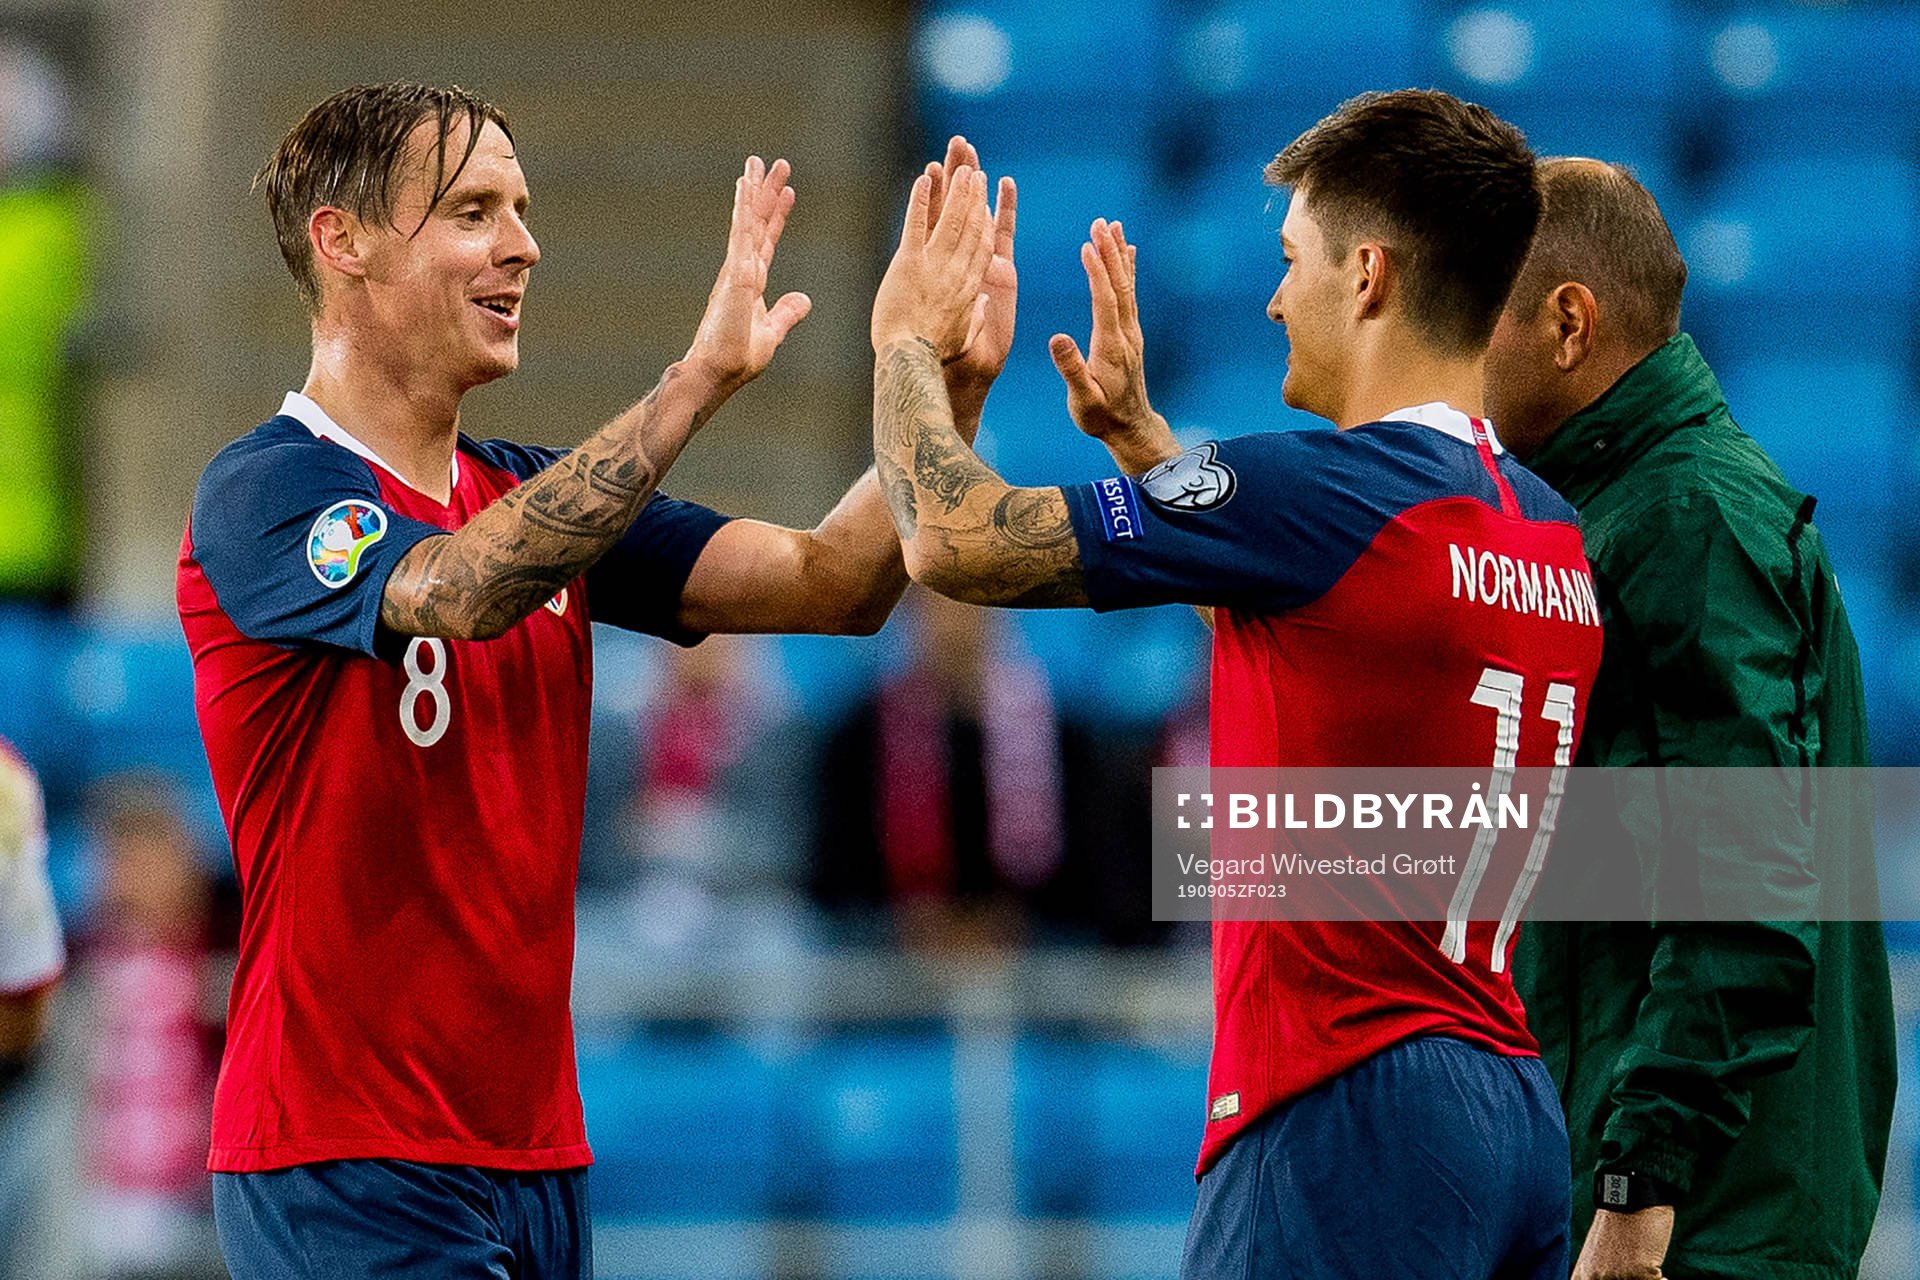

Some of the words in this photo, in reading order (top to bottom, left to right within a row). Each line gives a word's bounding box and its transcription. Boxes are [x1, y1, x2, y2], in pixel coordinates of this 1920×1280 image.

[1449, 543, 1600, 627] NORMANN
[400, 636, 450, 748] 8
[1438, 667, 1576, 974] 11
